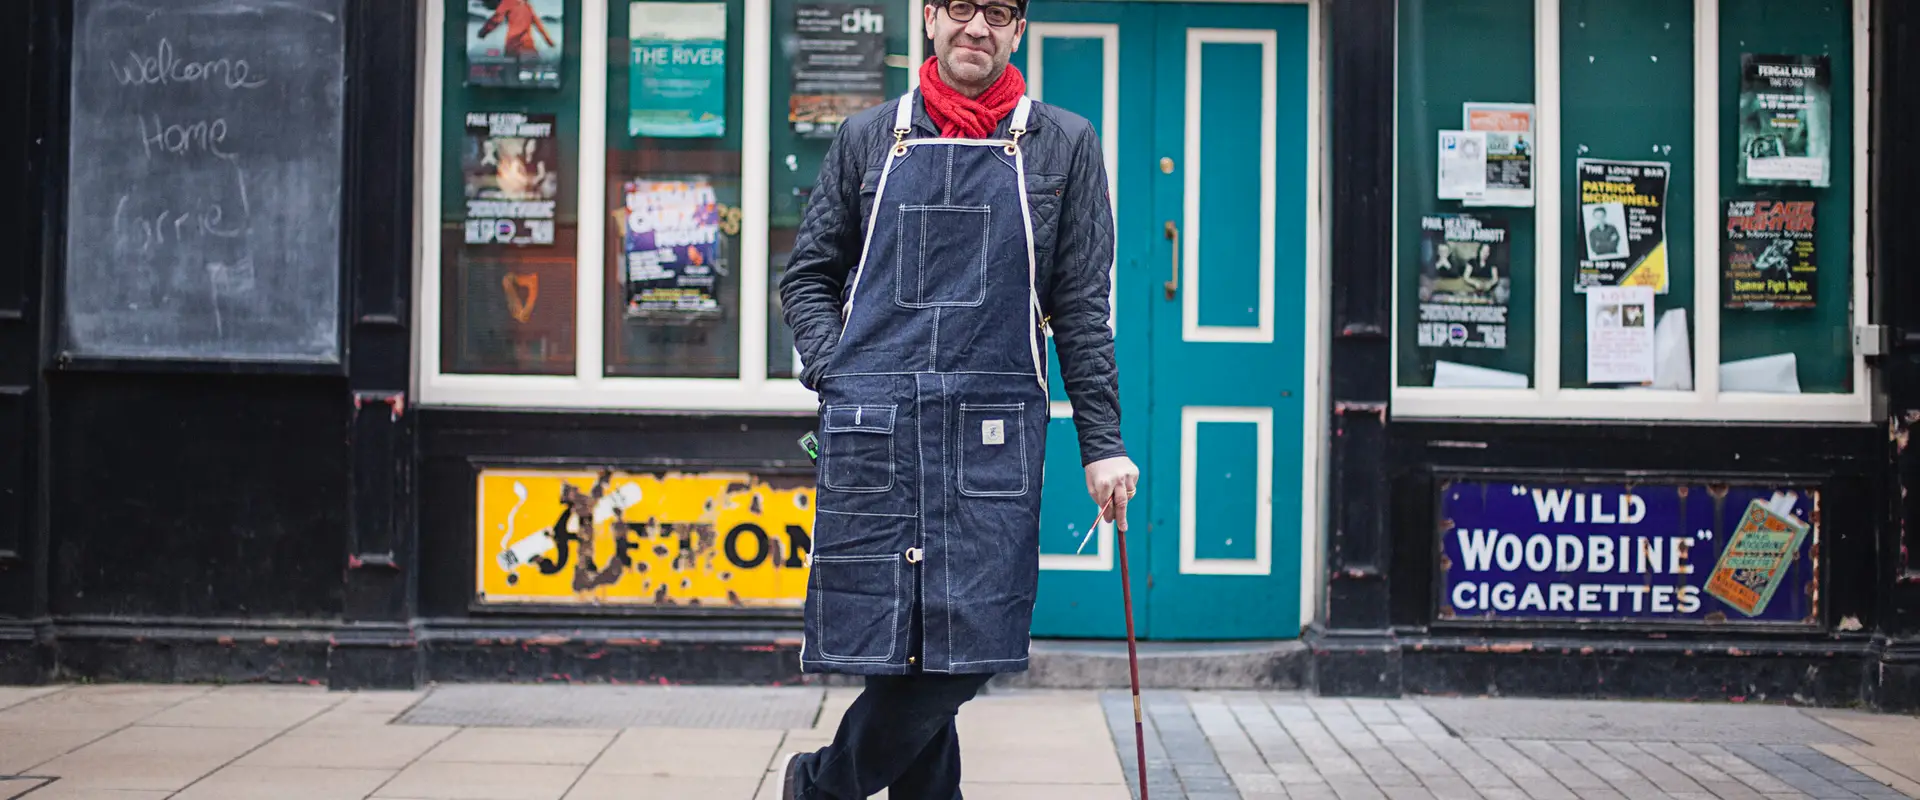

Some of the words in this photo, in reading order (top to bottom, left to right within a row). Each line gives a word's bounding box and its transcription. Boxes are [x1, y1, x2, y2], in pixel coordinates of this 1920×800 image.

[632, 47, 669, 65] THE
[672, 46, 724, 65] RIVER
[139, 115, 238, 160] Home
[1585, 165, 1604, 176] THE
[1607, 166, 1640, 177] LOCKE
[1644, 167, 1665, 179] BAR
[1582, 181, 1636, 194] PATRICK
[1754, 201, 1814, 218] CAGE
[1727, 216, 1815, 232] FIGHTER
[1734, 279, 1766, 292] Summer
[1767, 279, 1786, 294] Fight
[1788, 279, 1808, 294] Night
[1511, 485, 1647, 524] "WILD
[1457, 528, 1713, 574] WOODBINE"
[1451, 581, 1701, 613] CIGARETTES
